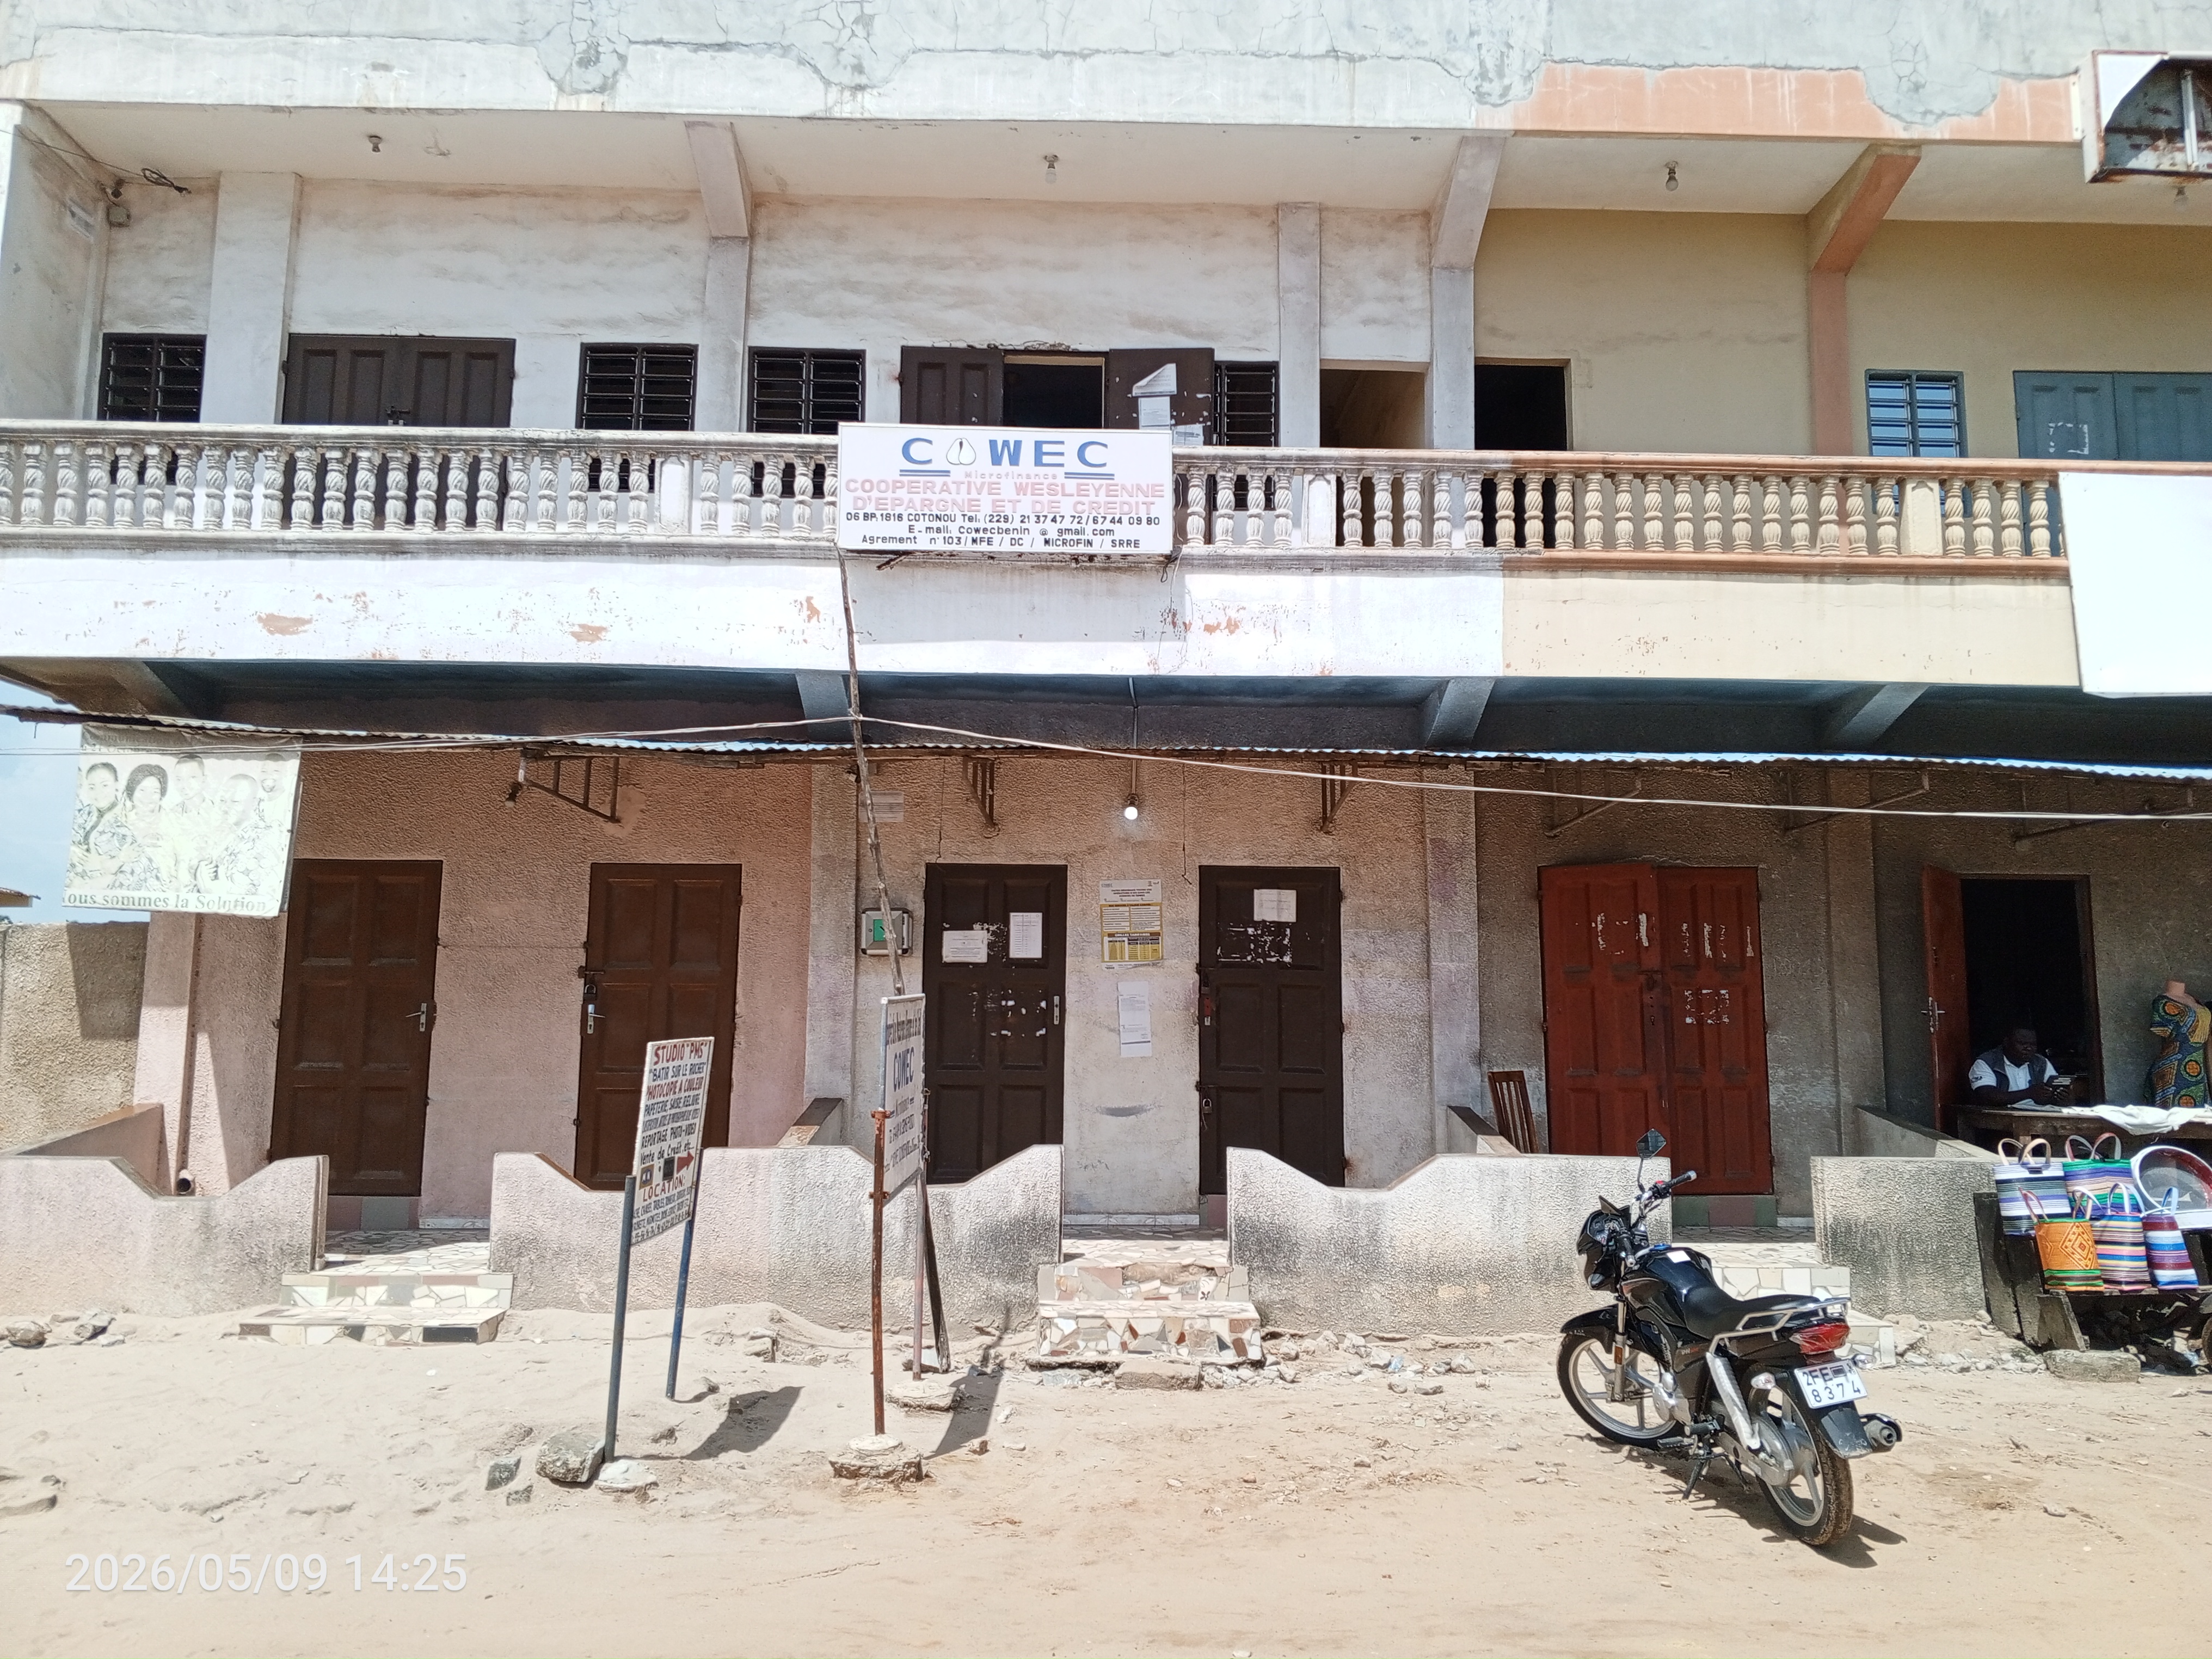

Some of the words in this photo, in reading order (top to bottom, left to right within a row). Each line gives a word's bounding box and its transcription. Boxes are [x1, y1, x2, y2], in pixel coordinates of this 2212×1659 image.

[964, 470, 1058, 480] Microfinance
[845, 478, 1001, 495] COOPERATIVE
[1014, 481, 1164, 497] WESLEYENNE
[852, 495, 981, 512] D'EPARGNE
[992, 498, 1021, 513] ET
[1031, 500, 1061, 514] DE
[1072, 500, 1155, 515] CREDIT
[846, 512, 860, 521] 06
[907, 513, 956, 523] COTONOU
[984, 514, 1014, 524] (229)
[1019, 515, 1030, 524] 21
[1035, 515, 1047, 524] 37
[1050, 515, 1065, 524] 47
[1109, 516, 1123, 525] 44
[1128, 517, 1142, 525] 09
[1146, 517, 1160, 525] 80
[958, 525, 1030, 535] Cowecbenin
[1039, 528, 1048, 536] @
[862, 534, 917, 544] Agrement
[971, 537, 993, 546] MFE
[1010, 537, 1023, 546] DC
[1044, 538, 1093, 548] MICROFIN
[1111, 539, 1140, 549] SRRE
[102, 894, 169, 908] sommes
[175, 894, 189, 909] la
[195, 895, 267, 913] Solution
[653, 1043, 685, 1066] STUDIO
[671, 1065, 681, 1078] SUR
[682, 1064, 688, 1077] LE
[893, 1046, 915, 1092] COWEC
[641, 1128, 668, 1150] REPORTAGE
[641, 1150, 655, 1165] Vente
[657, 1146, 665, 1160] de
